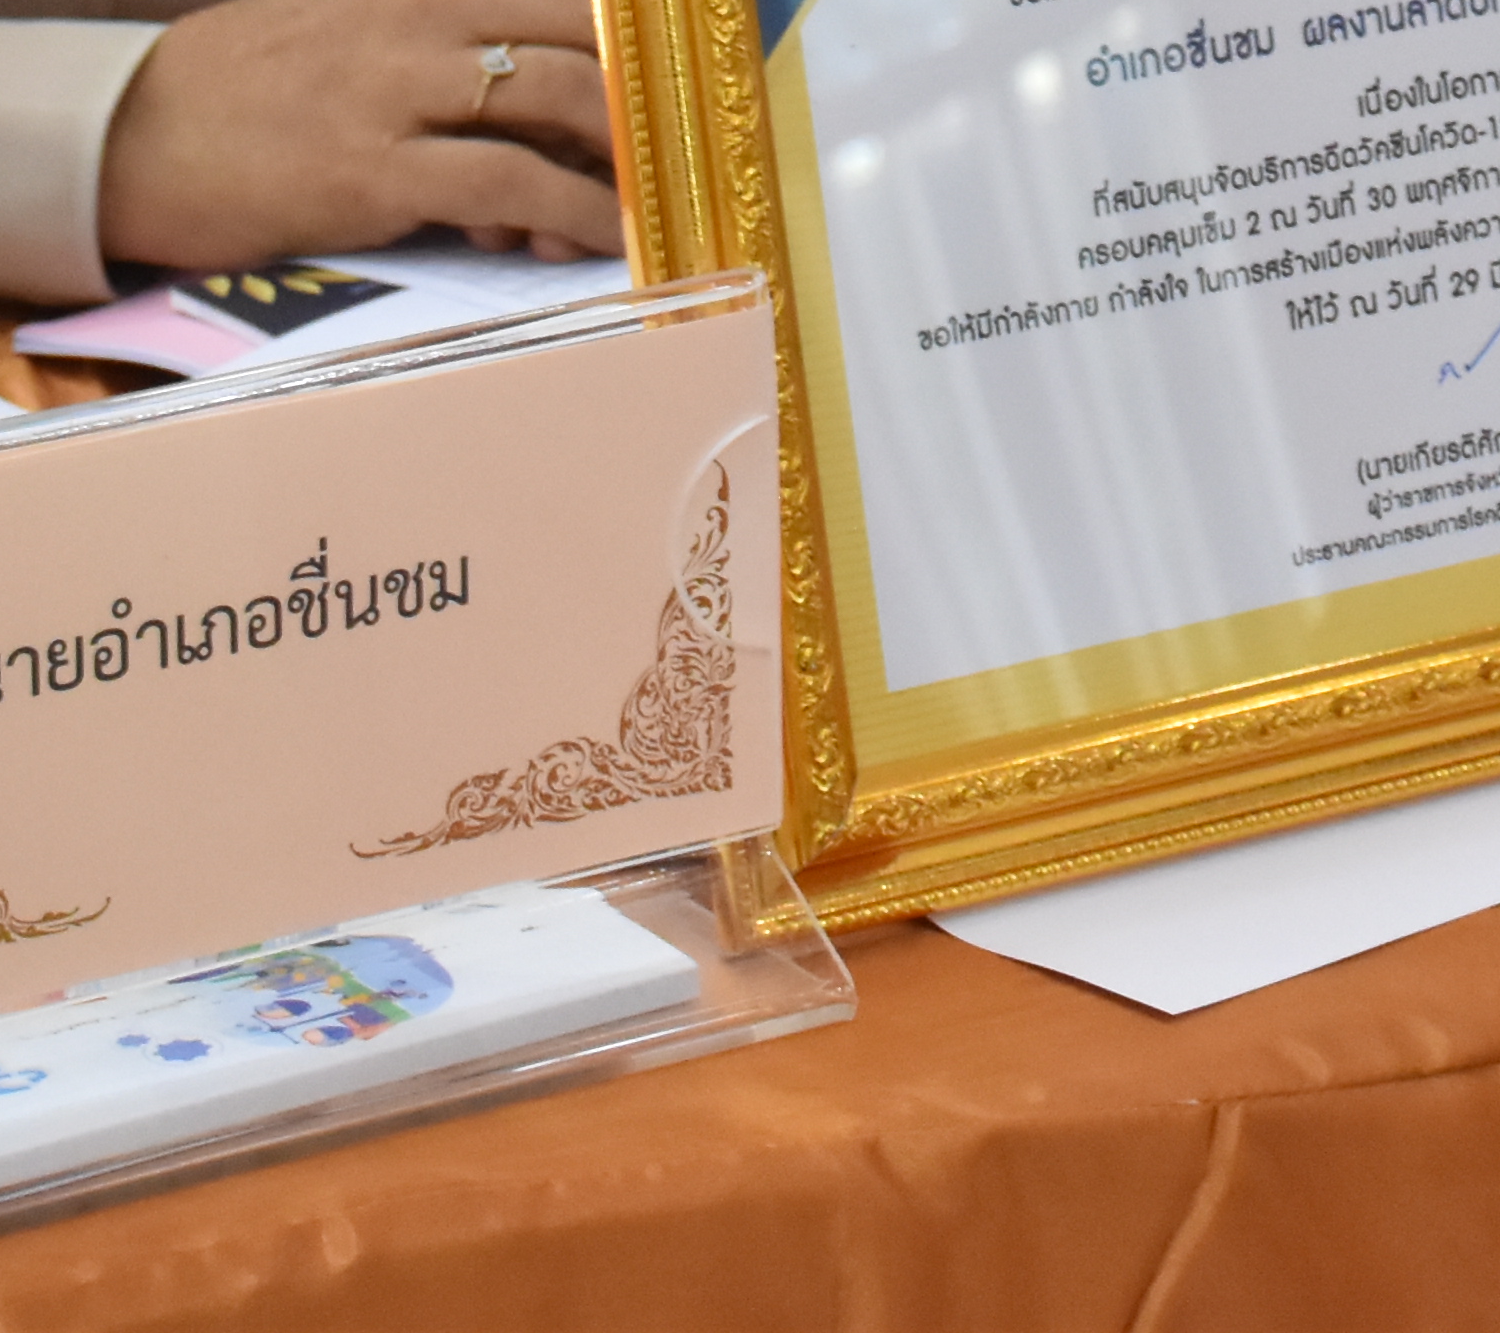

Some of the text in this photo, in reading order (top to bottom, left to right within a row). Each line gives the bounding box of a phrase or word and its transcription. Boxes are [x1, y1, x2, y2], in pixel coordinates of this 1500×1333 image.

[1086, 18, 1275, 87] อำเภอชื่นชม
[1246, 211, 1261, 236] 2
[1367, 184, 1397, 212] 30
[1449, 268, 1480, 298] 29
